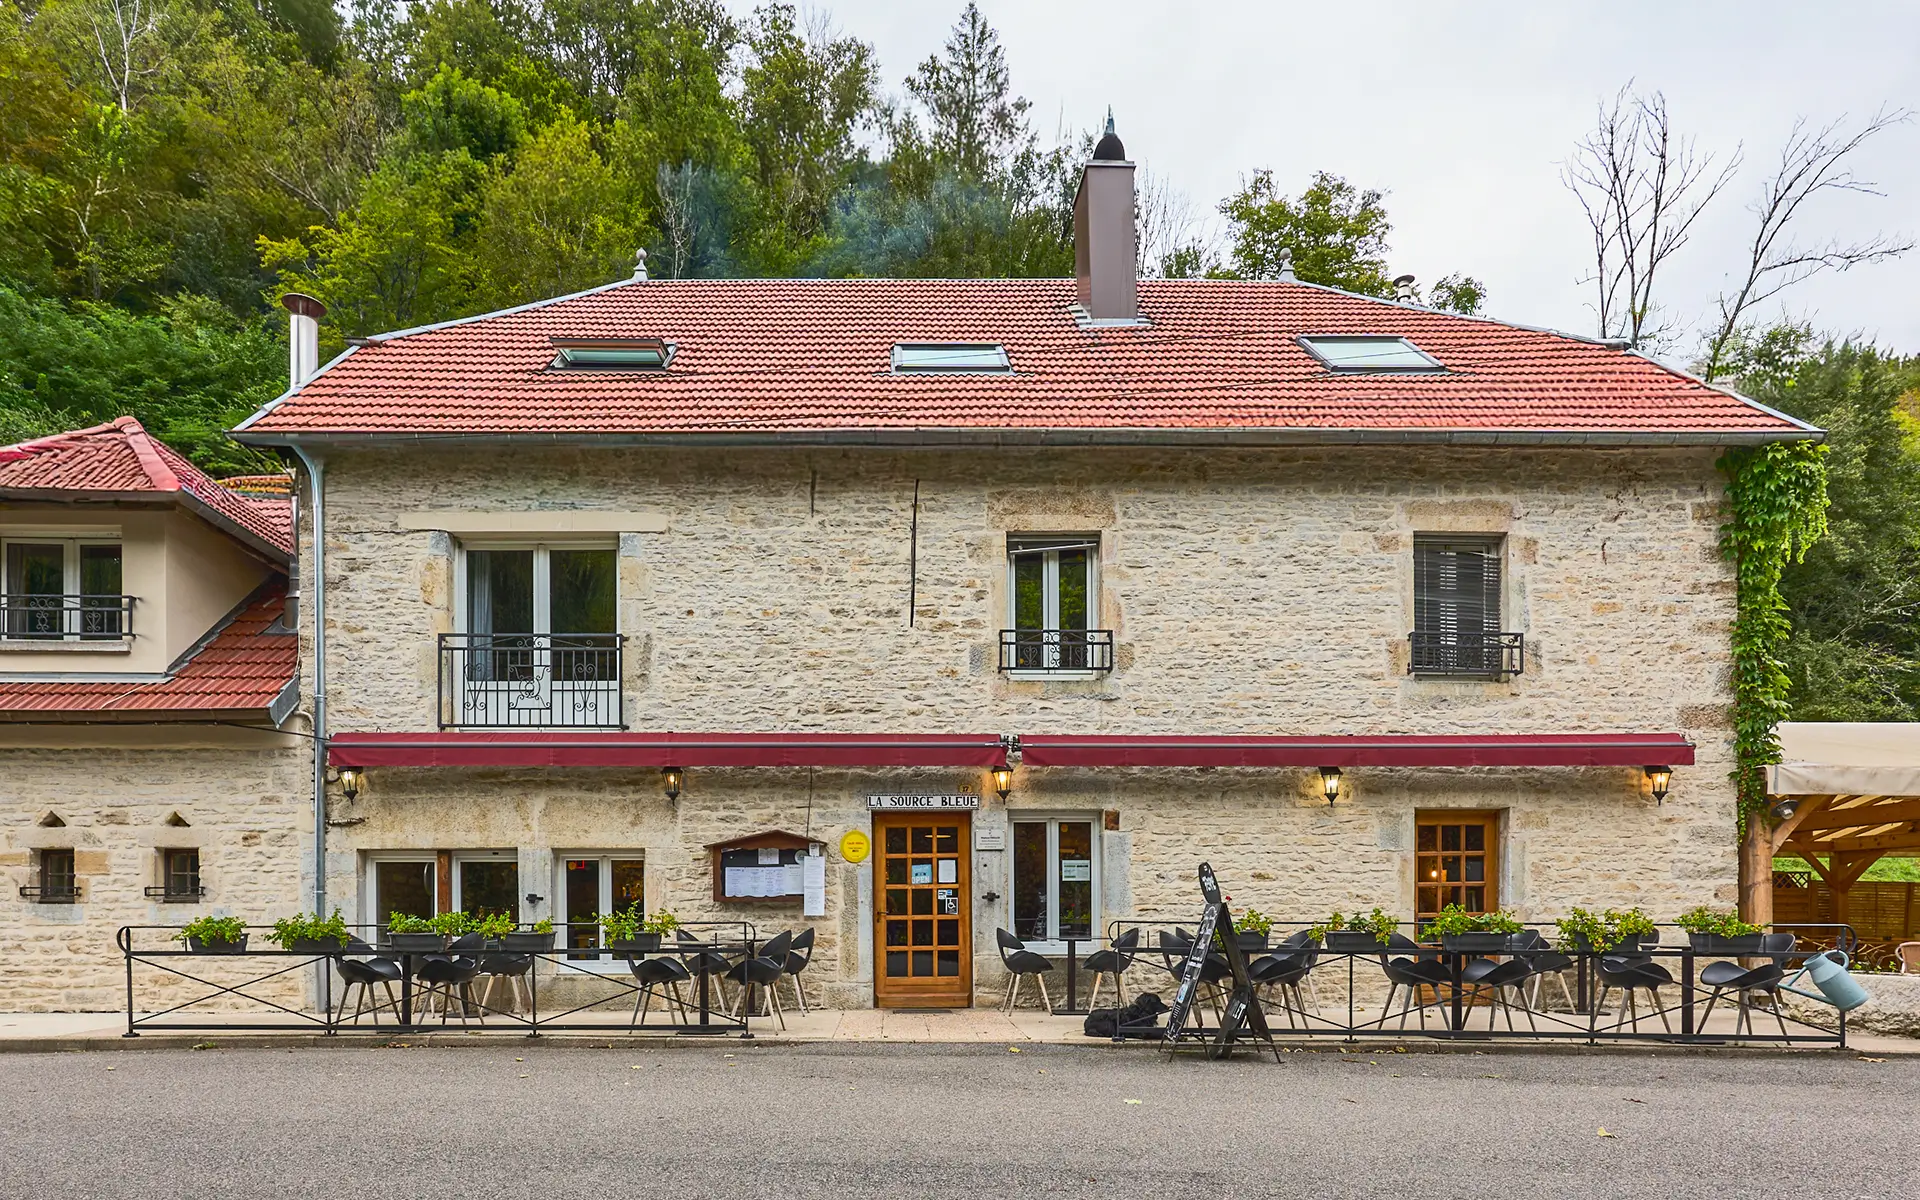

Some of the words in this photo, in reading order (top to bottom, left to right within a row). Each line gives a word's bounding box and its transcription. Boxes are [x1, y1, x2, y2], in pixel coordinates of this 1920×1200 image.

[868, 796, 883, 807] LA
[889, 796, 934, 807] SOURCE
[941, 796, 977, 807] BLEUE
[911, 876, 930, 884] OPEN
